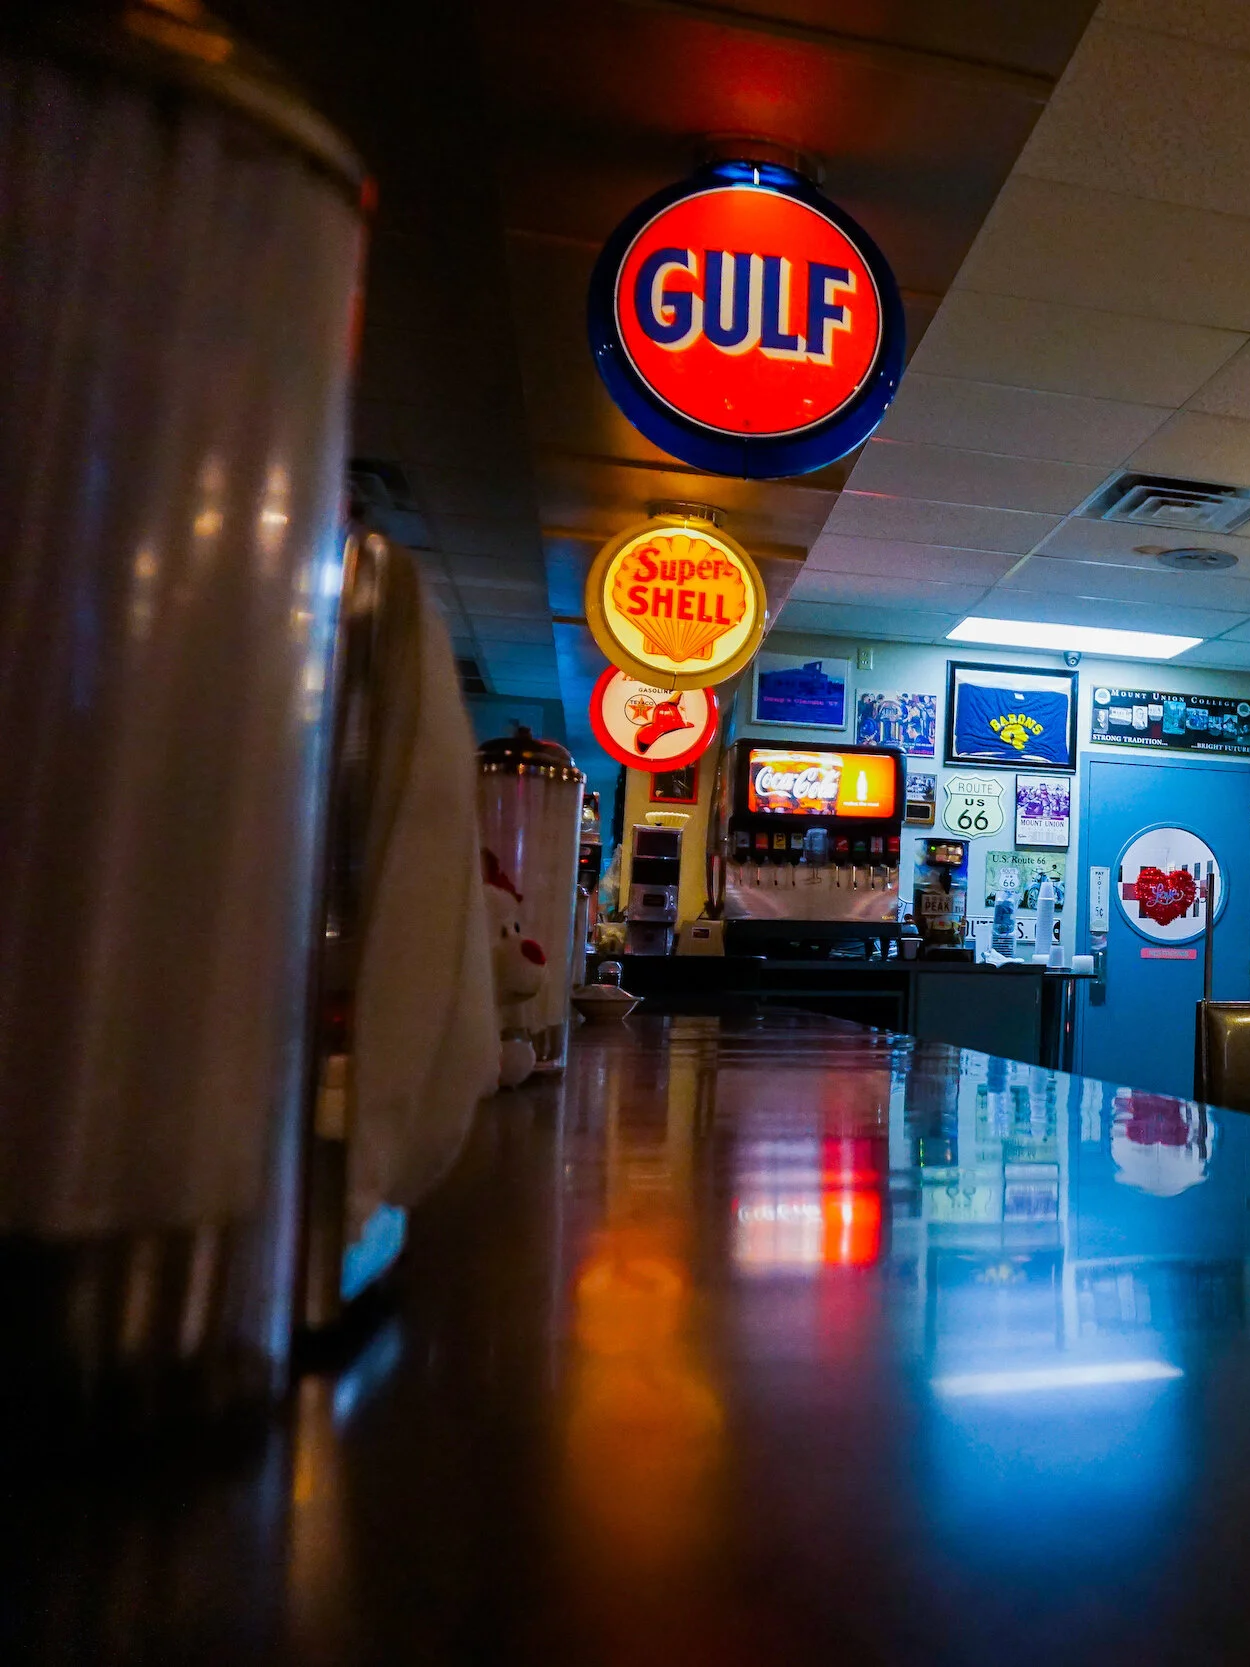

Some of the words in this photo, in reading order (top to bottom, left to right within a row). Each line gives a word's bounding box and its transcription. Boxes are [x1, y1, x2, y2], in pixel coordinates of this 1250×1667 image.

[635, 247, 857, 366] GULF
[626, 585, 731, 625] SHELL
[989, 713, 1044, 735] BARONS
[1092, 733, 1122, 743] STRONG
[754, 765, 841, 800] Coca-Cola
[958, 782, 993, 794] ROUTE
[964, 798, 985, 807] US
[957, 809, 989, 831] 66
[1020, 819, 1043, 827] MOUNT
[1044, 820, 1065, 828] UNION
[992, 854, 1009, 864] U.S.
[1011, 855, 1035, 865] Route
[1036, 857, 1046, 865] 66
[1003, 879, 1016, 888] 66
